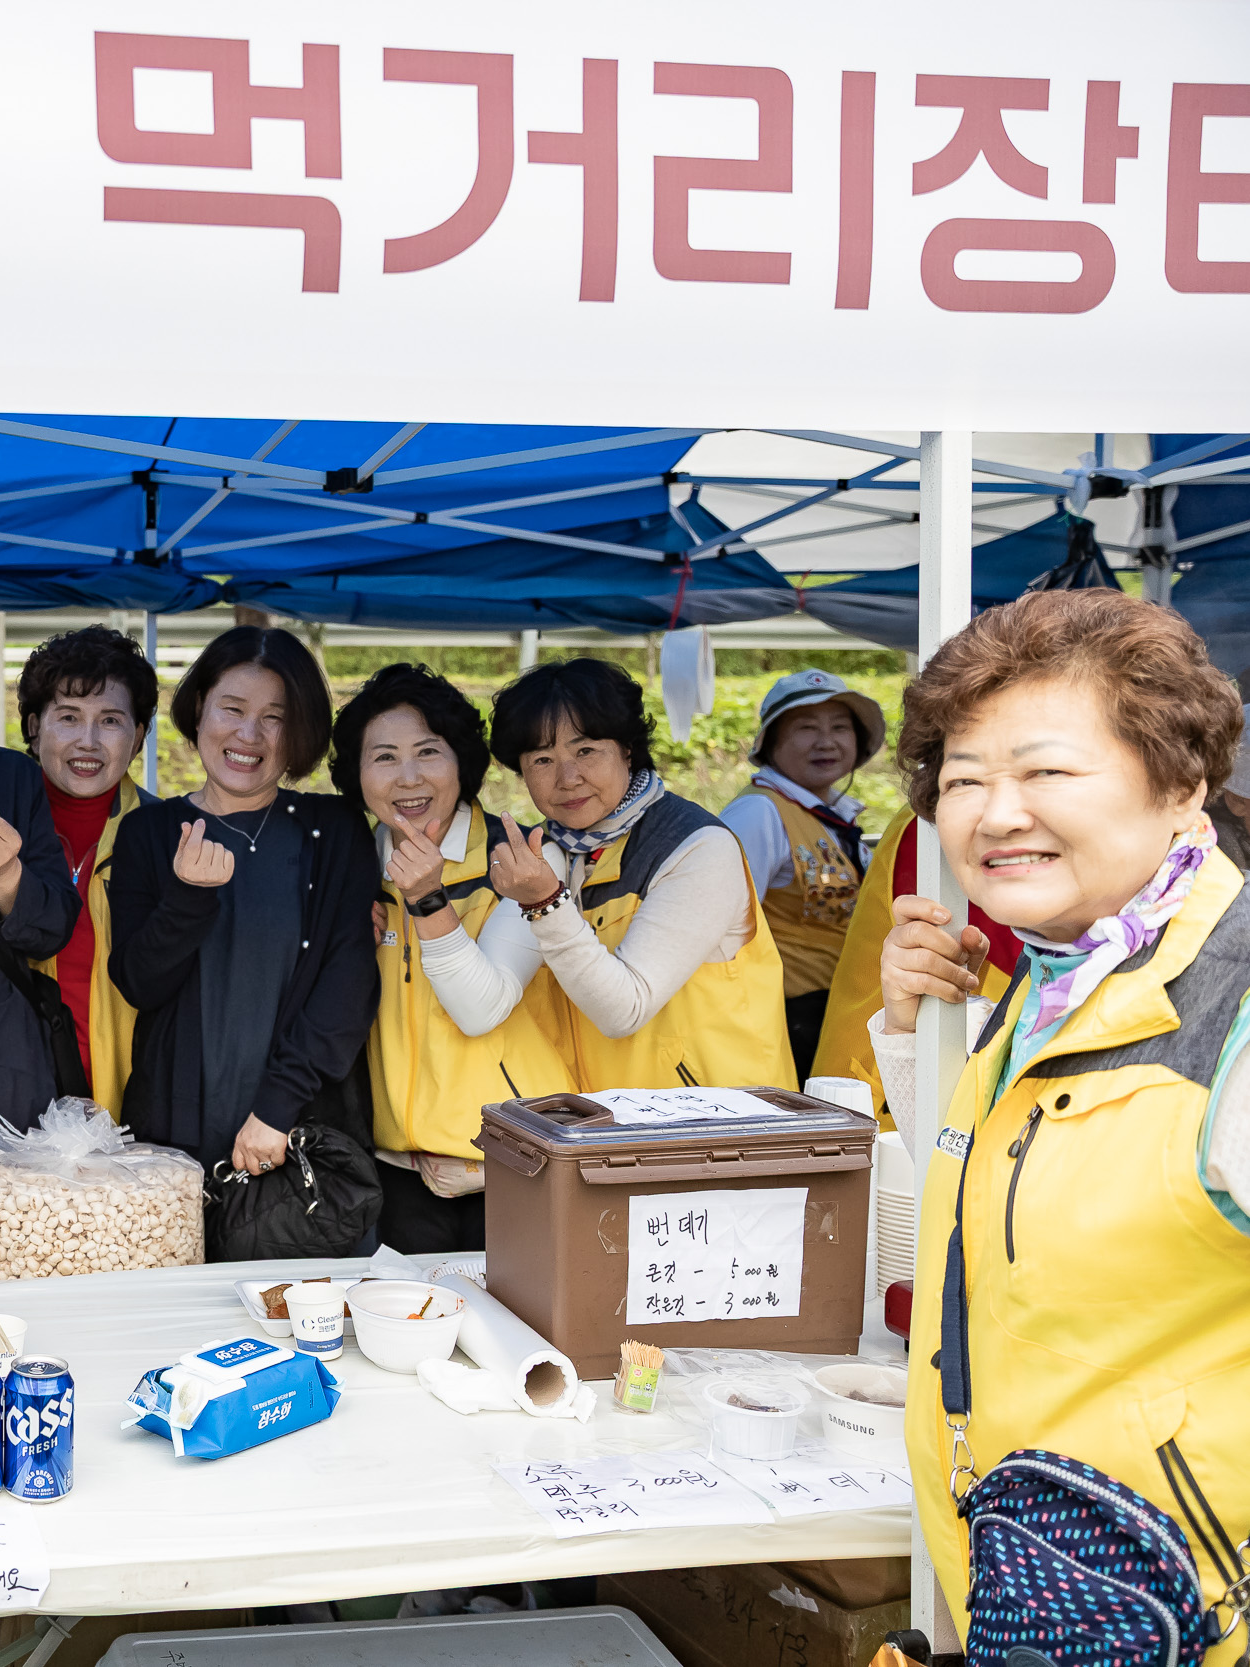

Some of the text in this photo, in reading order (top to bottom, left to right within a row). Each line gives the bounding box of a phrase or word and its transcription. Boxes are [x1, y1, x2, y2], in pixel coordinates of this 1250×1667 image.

[646, 1292, 685, 1316] 작은것
[827, 1412, 876, 1436] SAMSUNG
[22, 1436, 58, 1457] FRESH
